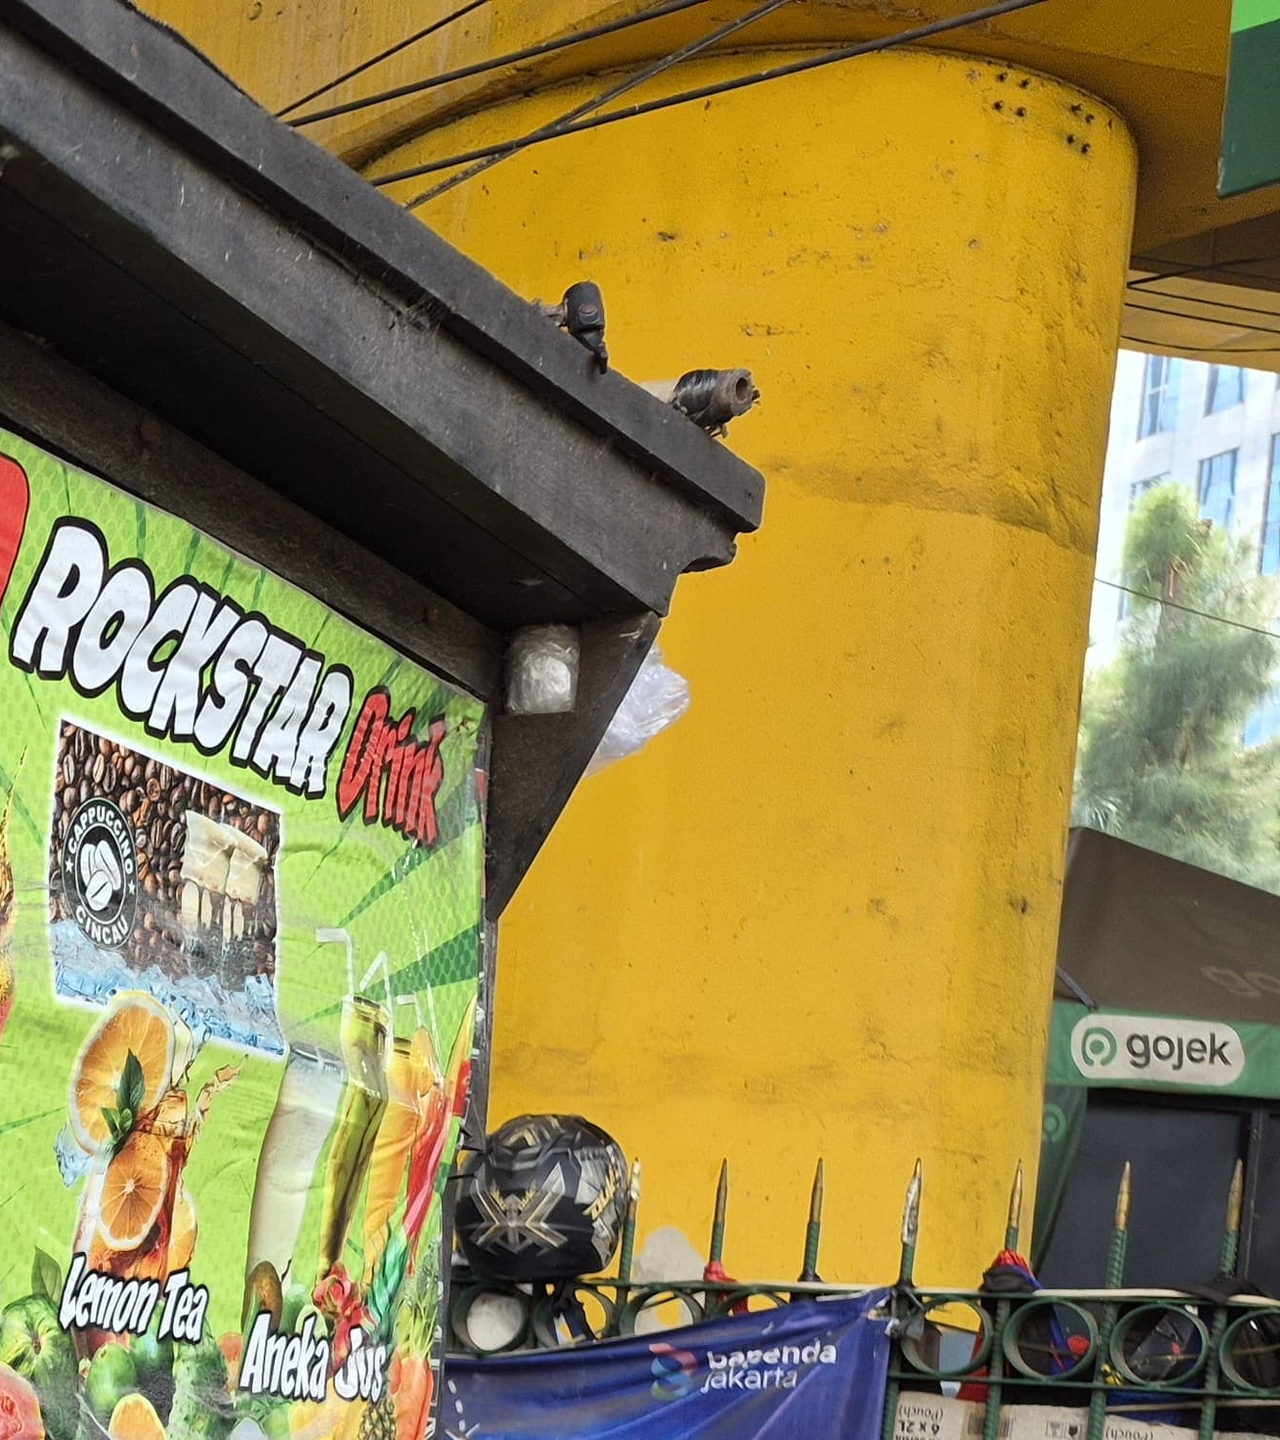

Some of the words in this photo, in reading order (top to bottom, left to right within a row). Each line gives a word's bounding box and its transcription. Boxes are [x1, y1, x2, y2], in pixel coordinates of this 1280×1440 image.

[9, 516, 353, 799] ROCKSTAR
[337, 686, 445, 849] Drink
[68, 805, 133, 874] CAPPUCCINO
[76, 905, 129, 944] CINCAU
[1126, 1032, 1232, 1070] gojek
[59, 1252, 160, 1335] Lemon
[158, 1268, 209, 1344] Tea
[240, 1311, 329, 1400] Aneka
[334, 1327, 388, 1402] Jus
